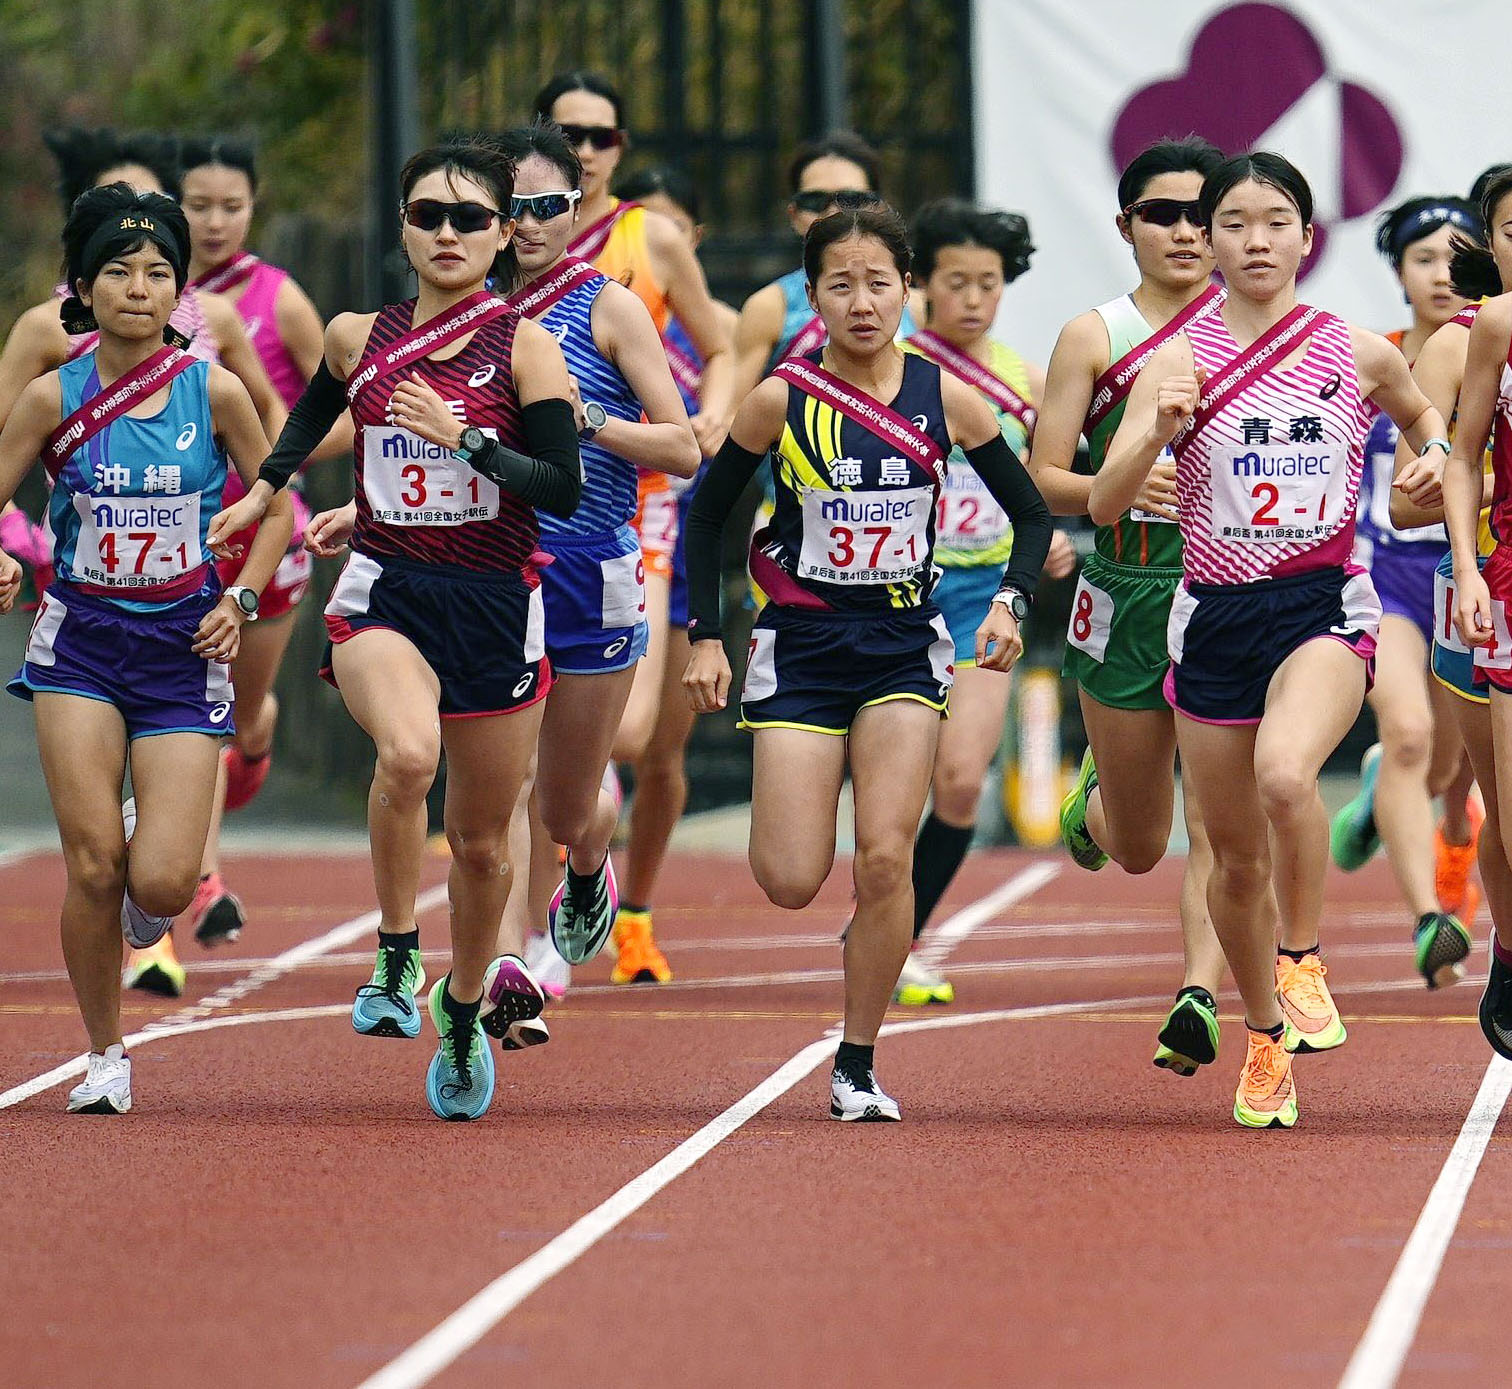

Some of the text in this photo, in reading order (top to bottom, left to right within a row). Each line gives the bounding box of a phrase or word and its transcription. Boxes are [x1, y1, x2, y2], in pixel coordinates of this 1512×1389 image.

[120, 217, 154, 231] 北山
[1240, 416, 1324, 445] 青森
[94, 463, 182, 495] 沖縄
[401, 464, 479, 508] 3-1
[829, 456, 911, 486] 徳島
[99, 532, 188, 574] 47-1
[828, 526, 917, 569] 37-1
[1073, 590, 1093, 642] 8
